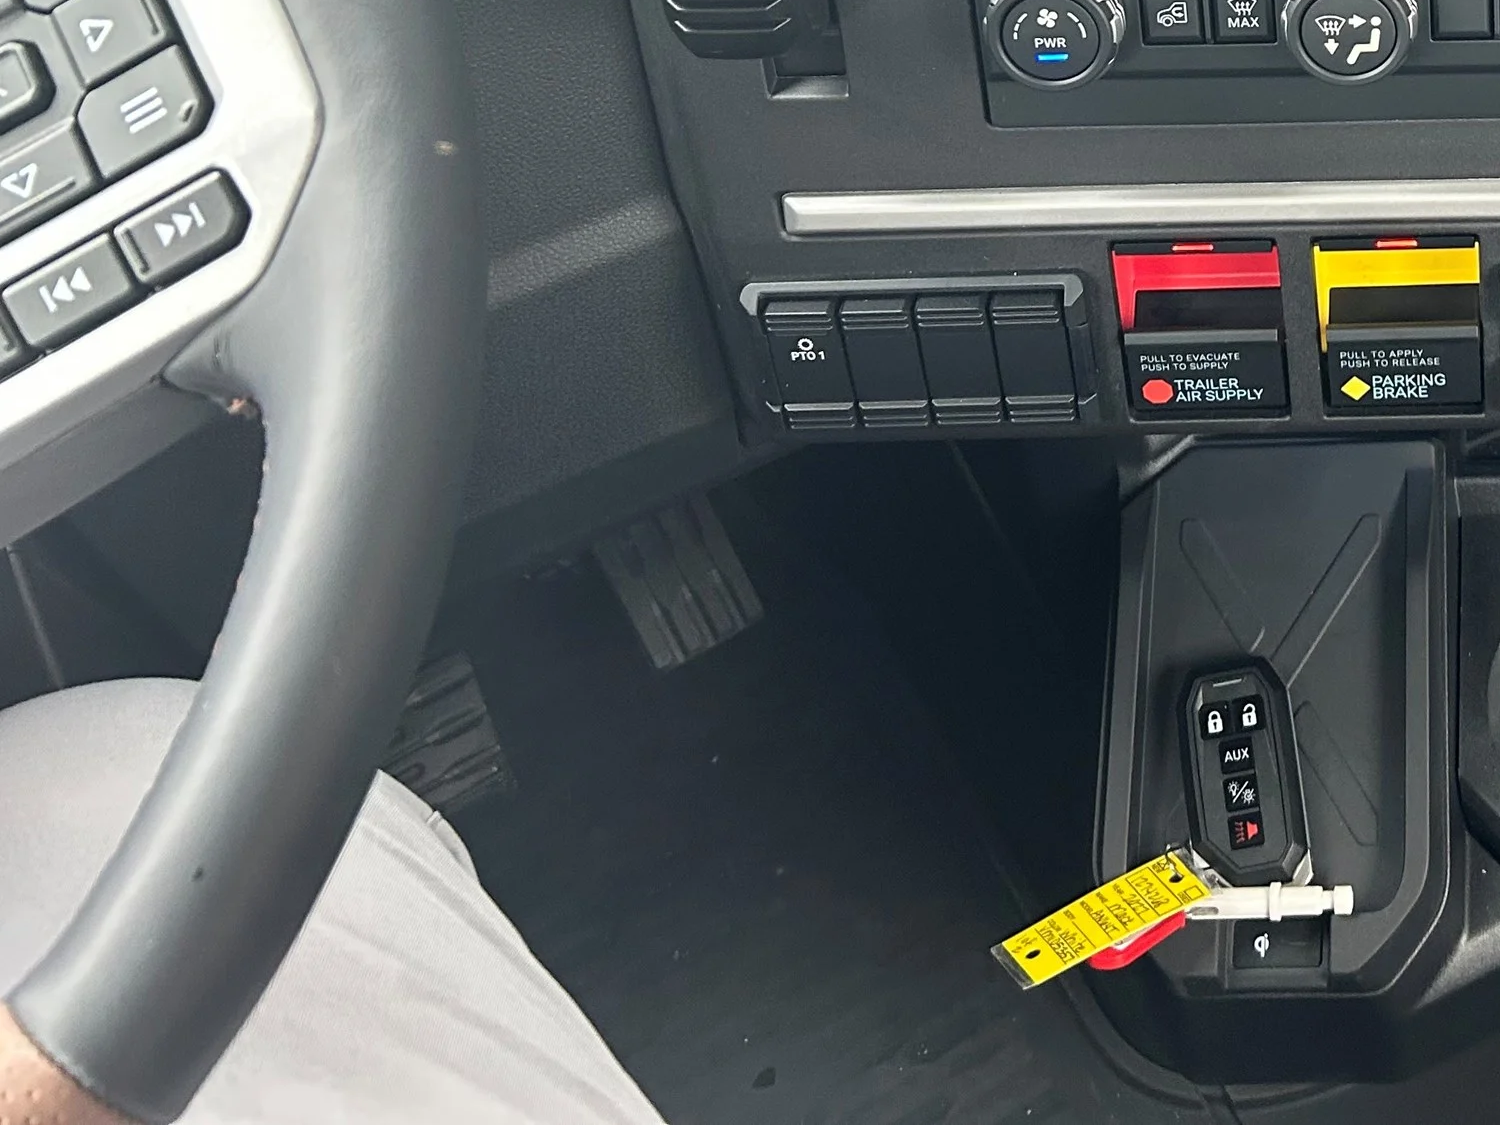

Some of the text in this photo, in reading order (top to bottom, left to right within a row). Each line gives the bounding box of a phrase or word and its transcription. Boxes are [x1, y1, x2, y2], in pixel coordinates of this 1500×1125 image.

[1227, 16, 1260, 28] MAX
[1034, 37, 1067, 49] PWR
[790, 350, 825, 361] PTO 1
[1139, 352, 1240, 364] PULL TO EVACUATE
[1339, 349, 1424, 360] PULL TO APPLY
[1141, 361, 1229, 372] PUSH TO SUPPLY
[1340, 355, 1440, 369] PUSH TO RELEASE
[1173, 377, 1239, 391] TRAILER
[1372, 373, 1446, 389] PARKING
[1175, 387, 1264, 403] AIR SUPPLY
[1372, 385, 1429, 400] BRAKE
[1224, 747, 1250, 763] AUX
